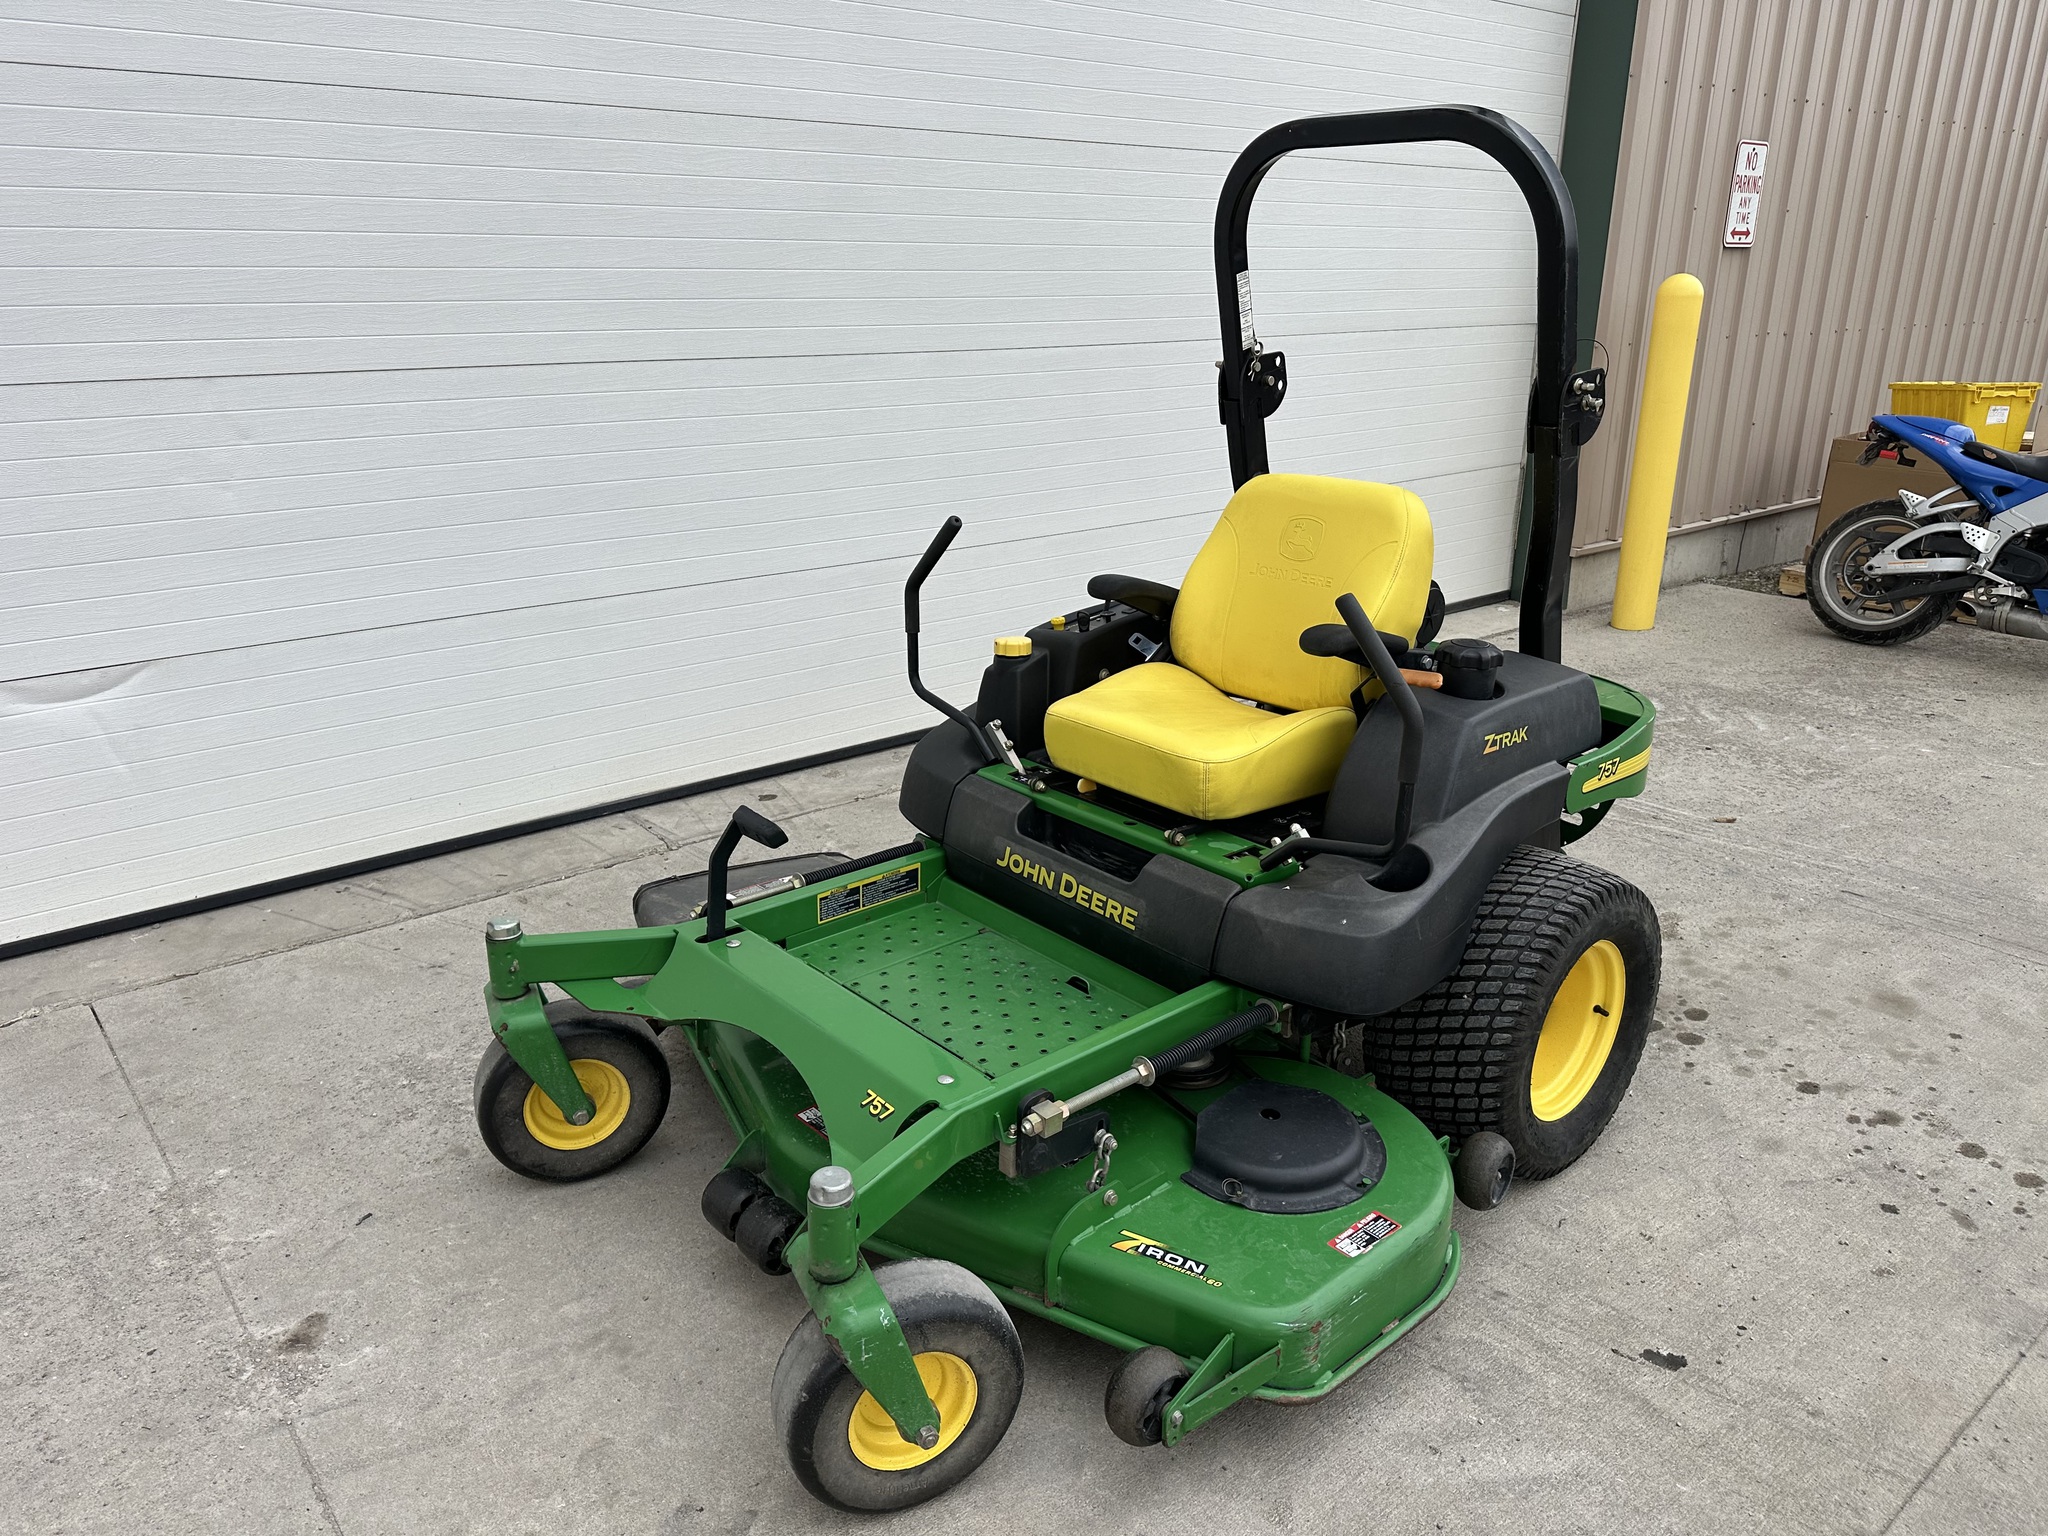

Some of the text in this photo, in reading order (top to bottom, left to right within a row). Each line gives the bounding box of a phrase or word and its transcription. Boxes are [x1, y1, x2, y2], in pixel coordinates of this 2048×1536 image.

[1745, 152, 1758, 171] NO
[1734, 174, 1762, 194] PARKING
[1738, 197, 1752, 209] ANY
[1735, 212, 1751, 225] TIME
[1249, 563, 1334, 588] JOHN DEERE
[1483, 725, 1529, 755] ZTRAK
[1597, 756, 1621, 781] 757
[996, 846, 1139, 931] JOHN DEERE
[860, 1088, 895, 1122] 757
